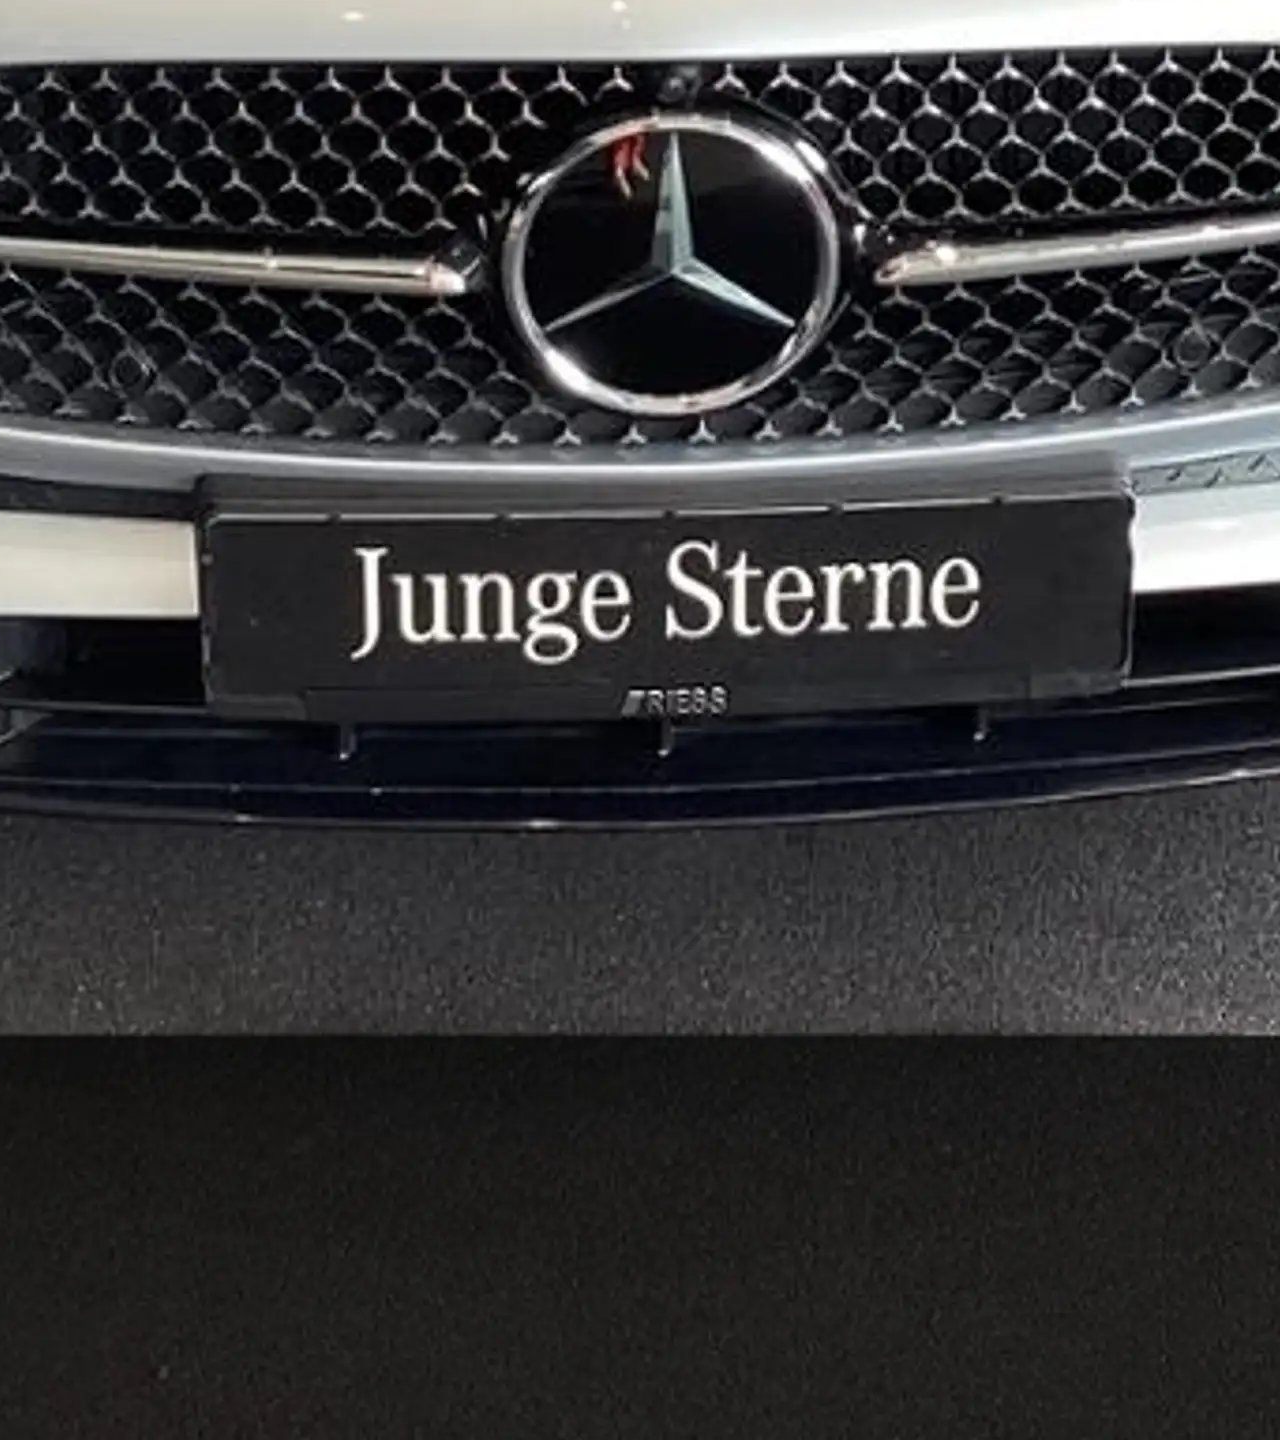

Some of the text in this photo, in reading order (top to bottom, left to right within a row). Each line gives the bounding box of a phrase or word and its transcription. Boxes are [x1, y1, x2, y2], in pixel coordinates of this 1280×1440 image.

[350, 539, 981, 665] Junge Sterne
[646, 685, 728, 715] RIESS
